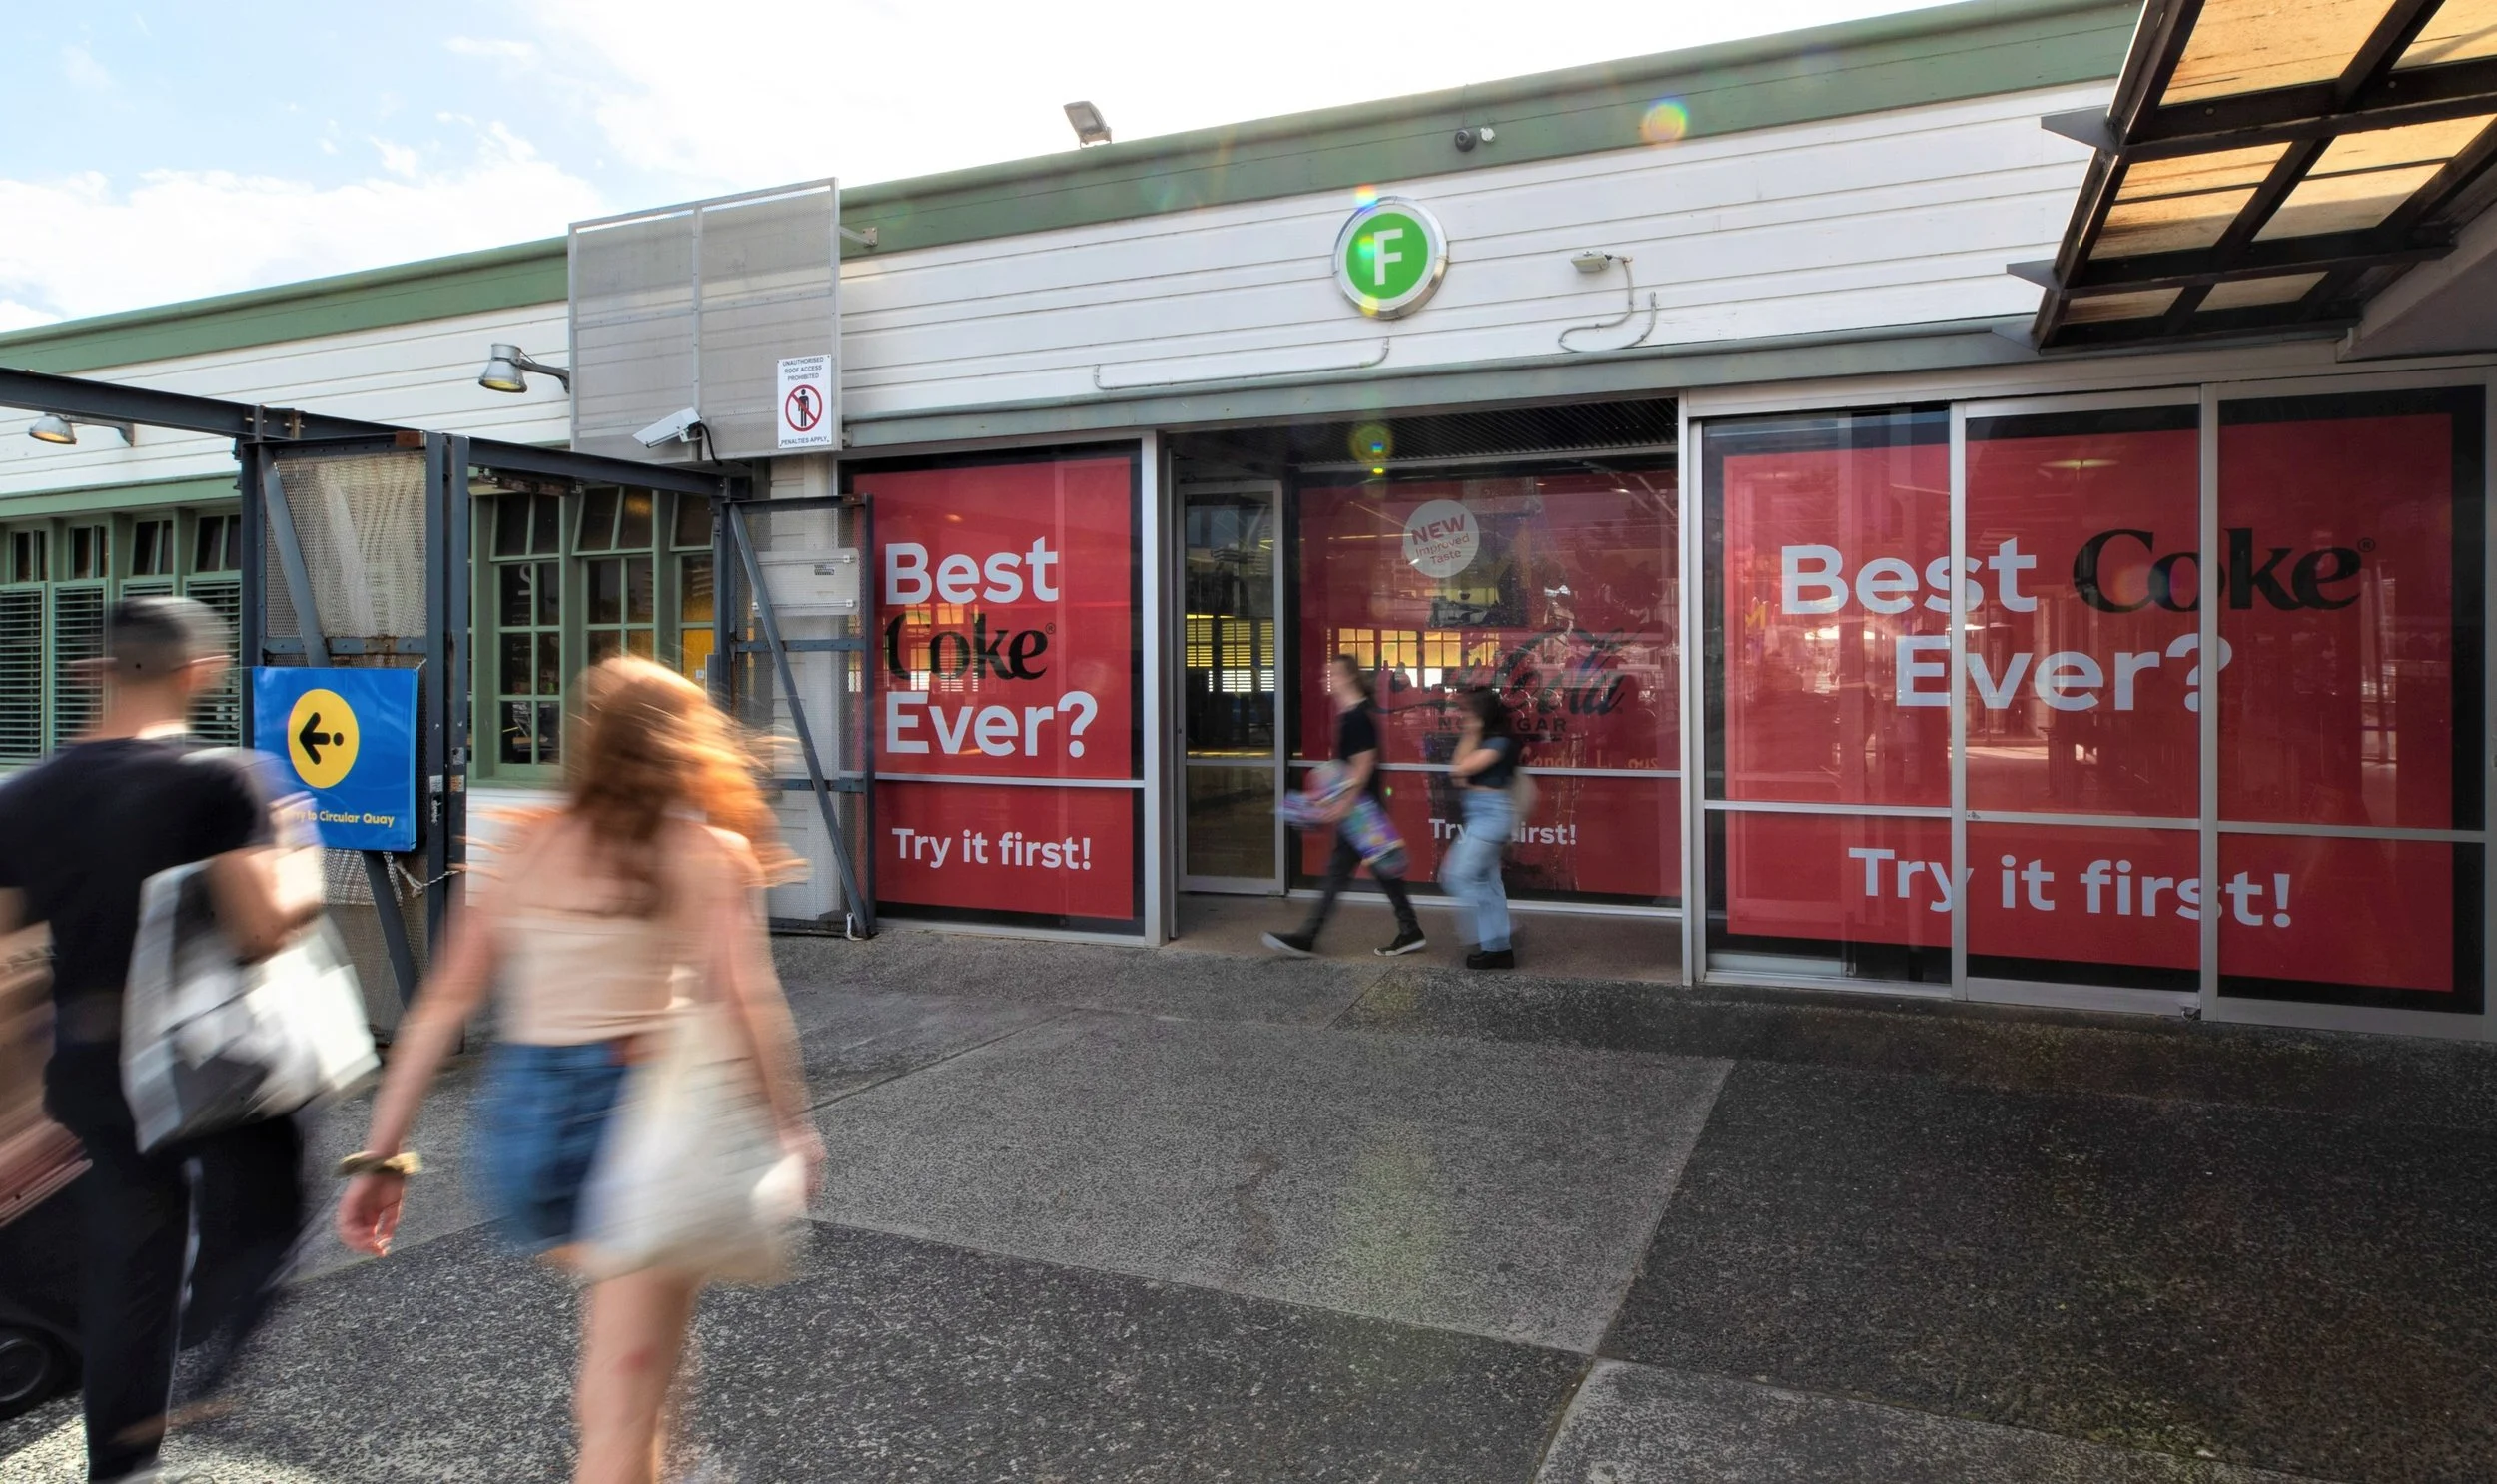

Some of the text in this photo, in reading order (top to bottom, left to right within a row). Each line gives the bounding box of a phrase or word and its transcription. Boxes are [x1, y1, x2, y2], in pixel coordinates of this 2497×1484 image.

[1373, 228, 1403, 286] F
[782, 357, 824, 367] UNAUTHORISED
[1411, 514, 1465, 545] NEW
[1415, 533, 1470, 557] Improved
[885, 536, 1059, 605] Best
[1430, 550, 1461, 564] Taste
[1780, 536, 2037, 615] Best
[1895, 633, 2233, 713] Ever?
[885, 690, 1098, 759] Ever?
[320, 810, 360, 823] Circular
[363, 813, 395, 828] Quay
[1511, 821, 1576, 846] irst!
[891, 828, 1092, 870] Try it first!
[1848, 847, 2292, 929] Try it first!
